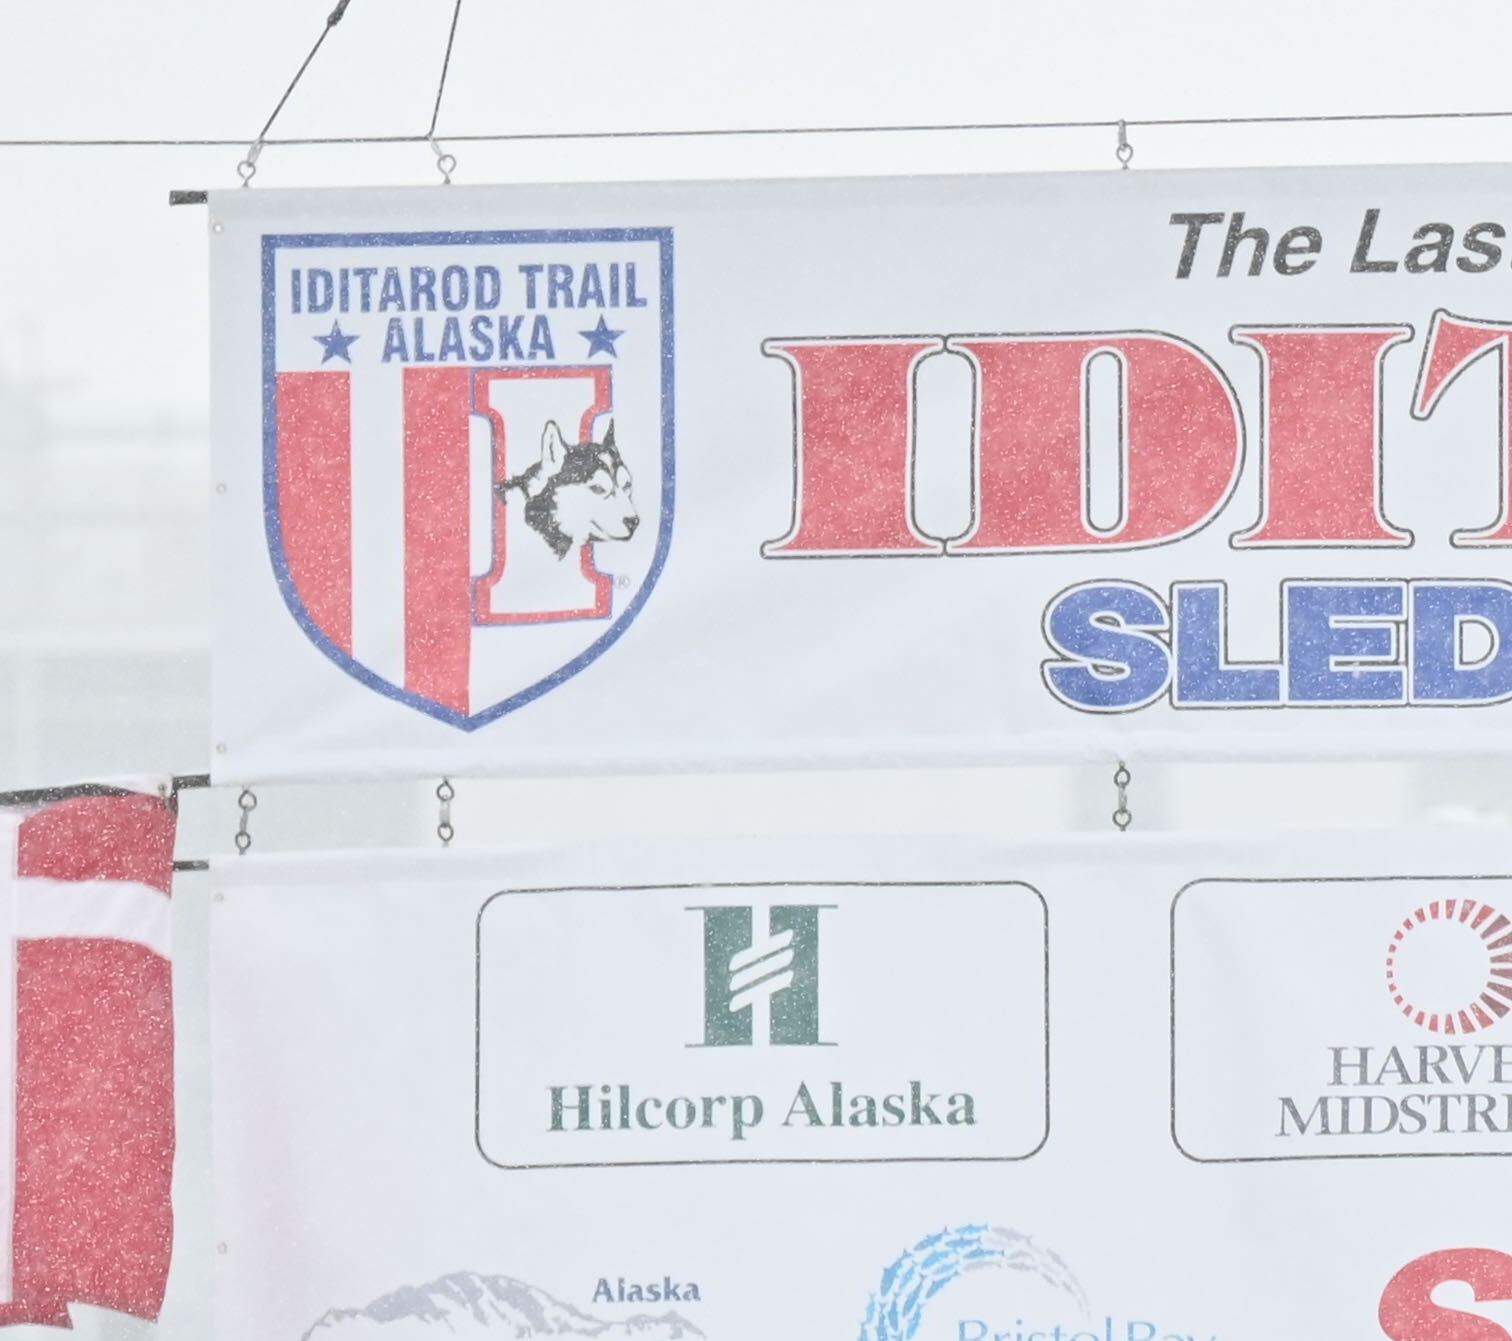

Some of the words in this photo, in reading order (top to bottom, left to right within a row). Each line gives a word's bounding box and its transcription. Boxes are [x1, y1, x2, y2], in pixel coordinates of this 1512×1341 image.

[1169, 211, 1322, 279] The
[291, 264, 501, 314] IDITAROD
[518, 262, 648, 310] TRAIL
[381, 314, 556, 363] ALASKA
[545, 1080, 765, 1140] Hilcorp
[781, 1078, 979, 1132] Alaska
[592, 1276, 702, 1303] Alaska
